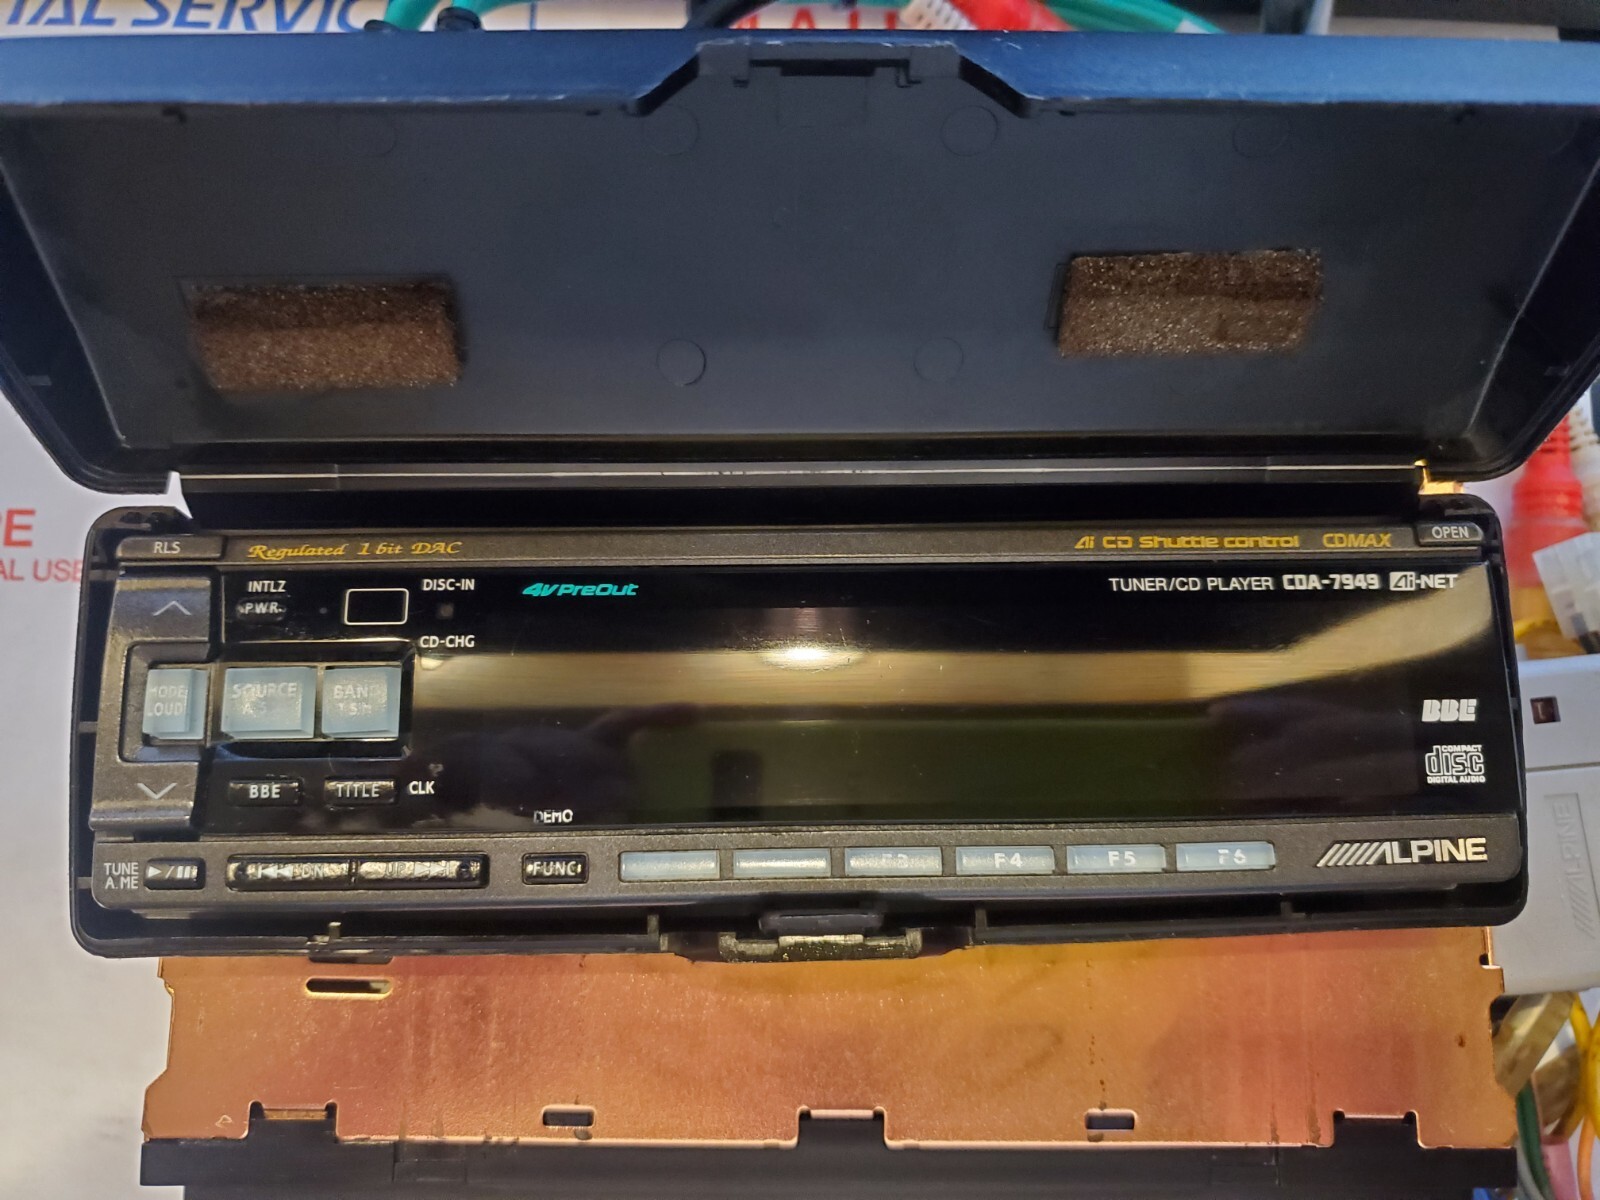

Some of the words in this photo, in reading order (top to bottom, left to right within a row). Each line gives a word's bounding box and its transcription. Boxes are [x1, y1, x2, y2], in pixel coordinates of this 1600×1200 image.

[1431, 526, 1470, 539] OPEN
[153, 541, 181, 554] RLS
[1102, 536, 1134, 549] CD
[1138, 535, 1219, 549] Shuttle
[1222, 535, 1300, 548] control
[1322, 533, 1392, 548] CDMAX
[247, 543, 349, 561] Regulated
[356, 542, 371, 556] 1
[375, 542, 402, 556] bit
[411, 541, 463, 555] DAC
[248, 580, 287, 593] INTLZ
[422, 578, 476, 591] DISC-IN
[1108, 577, 1201, 592] TUNER/CD
[1206, 576, 1275, 591] PLAYER
[1282, 573, 1381, 591] CDA-7949
[419, 634, 476, 648] CD-CHG
[231, 682, 298, 699] SOURCE
[1421, 698, 1478, 722] BBE
[1441, 744, 1483, 753] COMPACT
[1426, 776, 1459, 784] DIGITAL
[1459, 775, 1487, 783] AUDIO
[249, 784, 281, 799] BBE
[336, 783, 381, 798] TITLE
[408, 781, 435, 795] CLK
[533, 808, 574, 824] DEMO
[1107, 850, 1137, 866] F5
[1361, 836, 1489, 865] ALPINE
[993, 852, 1023, 869] F4
[104, 862, 139, 876] TUNE
[532, 861, 577, 876] FUNC
